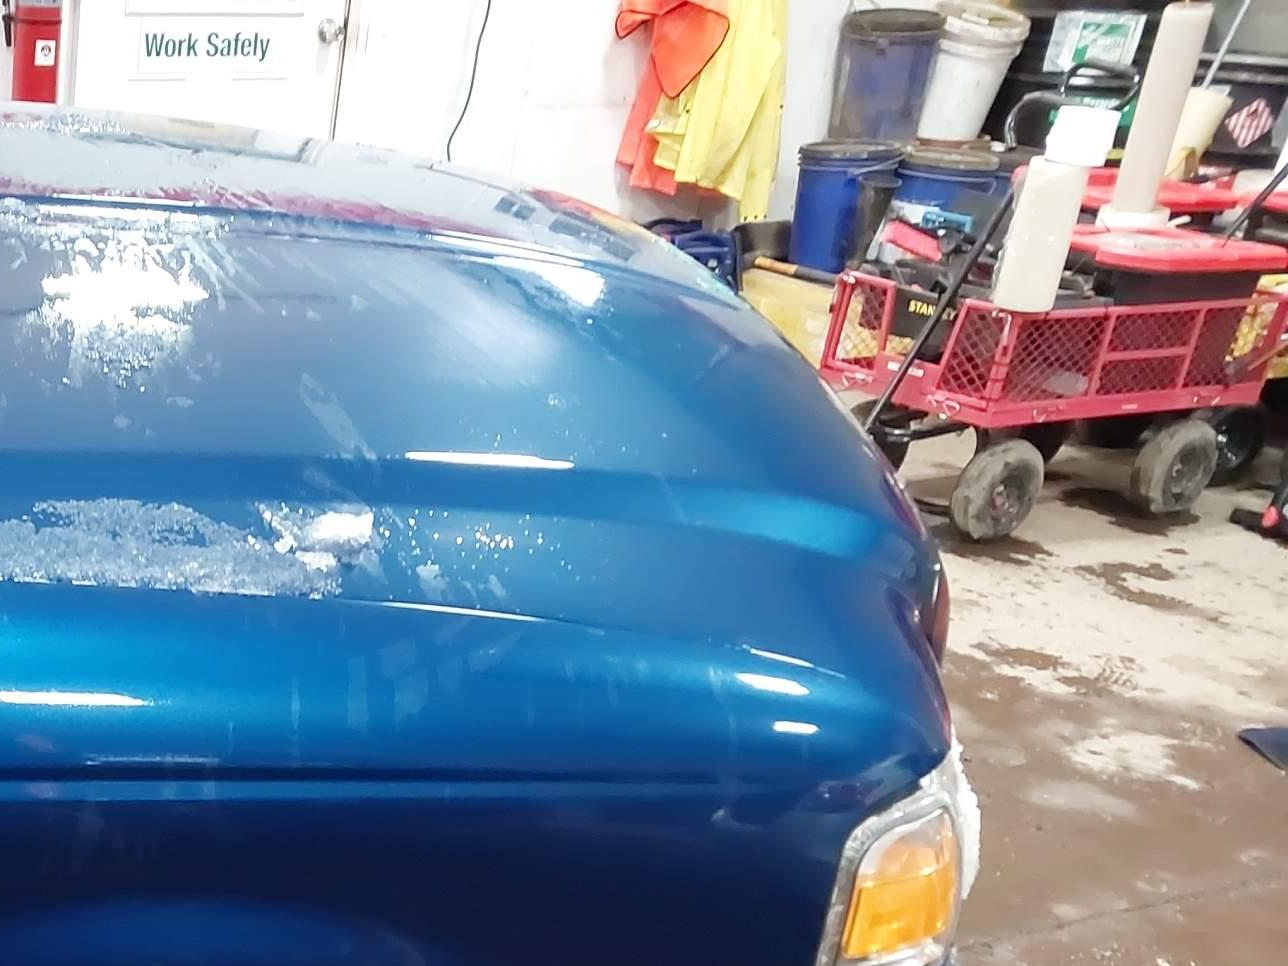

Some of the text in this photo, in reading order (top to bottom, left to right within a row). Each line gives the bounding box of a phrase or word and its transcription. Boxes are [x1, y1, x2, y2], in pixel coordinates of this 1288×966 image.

[144, 31, 271, 62] Work Safely
[908, 299, 958, 321] STANEY
